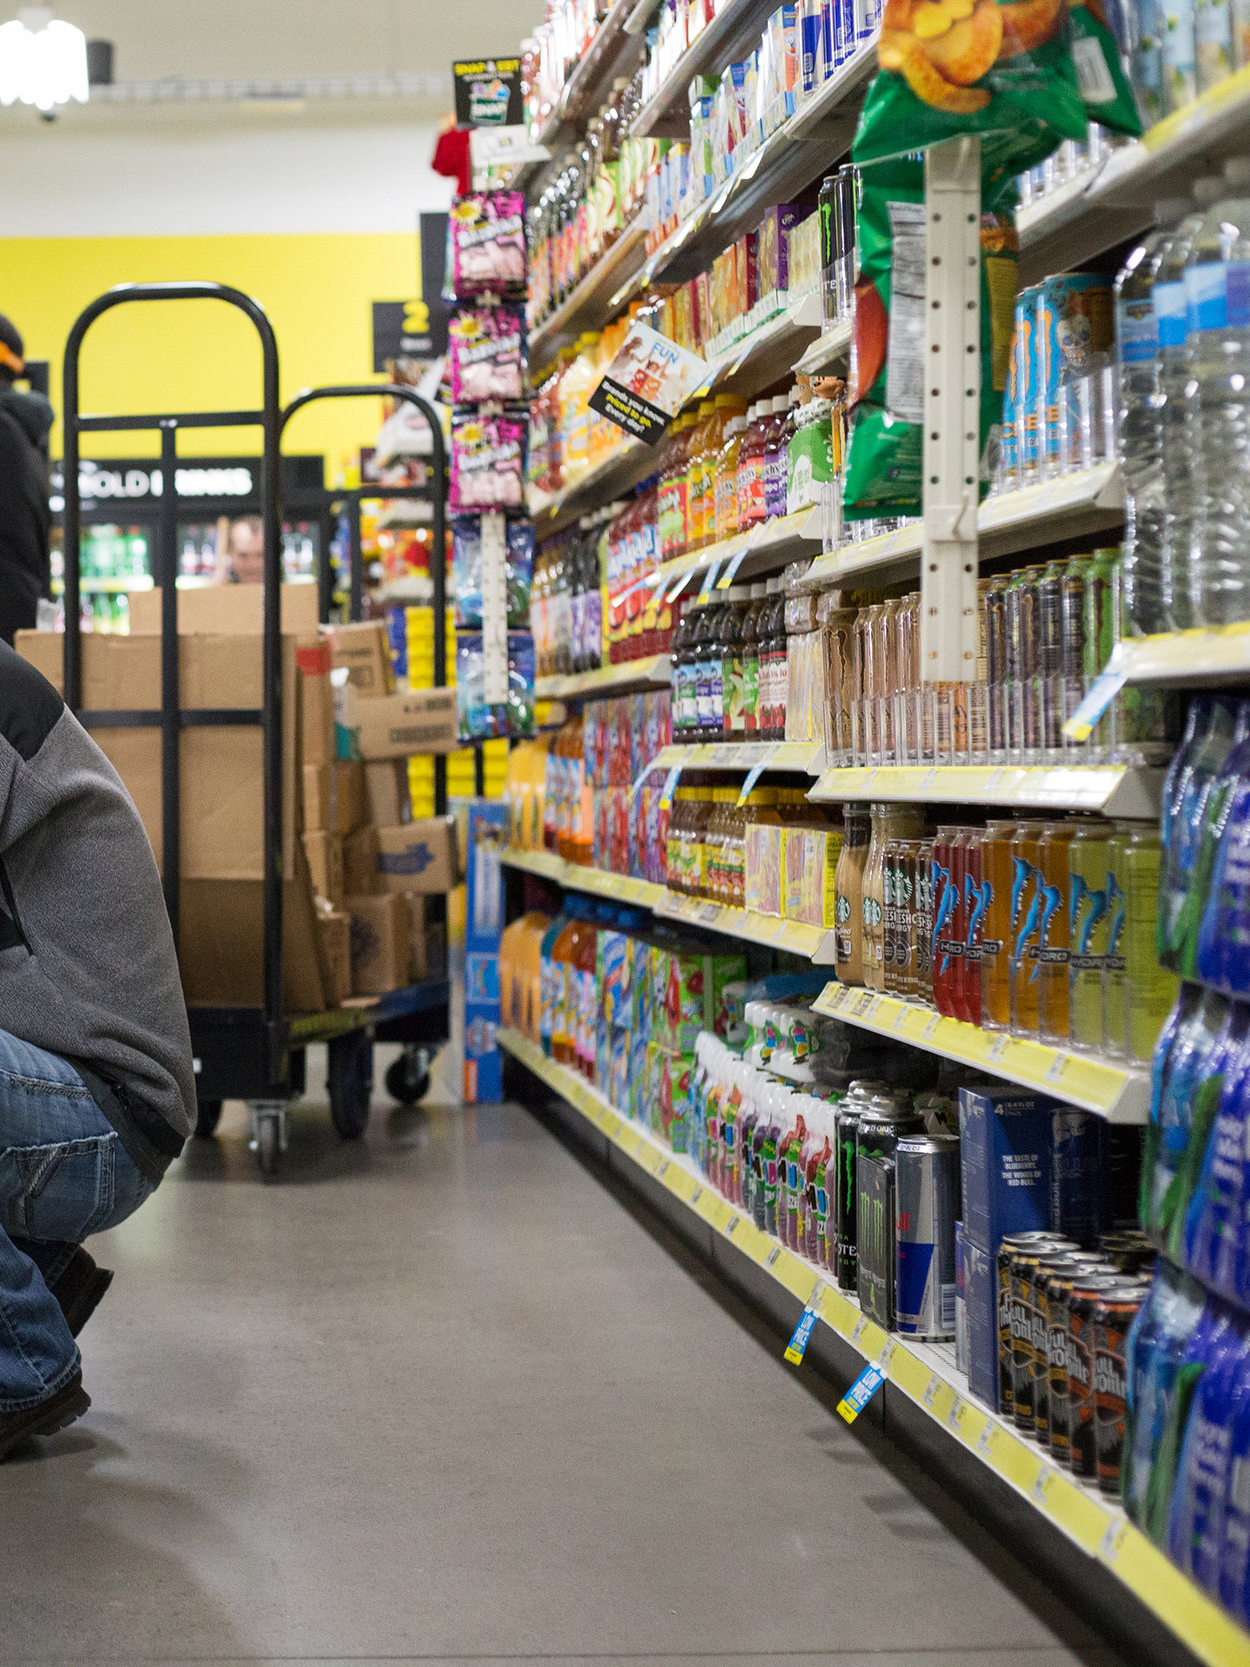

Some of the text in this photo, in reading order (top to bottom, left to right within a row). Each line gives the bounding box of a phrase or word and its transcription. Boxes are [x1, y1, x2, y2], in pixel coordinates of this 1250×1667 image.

[402, 300, 431, 334] 2
[651, 342, 679, 364] FUN
[994, 1103, 1004, 1116] 4
[1001, 1171, 1013, 1179] THE
[861, 1368, 882, 1391] LOW
[850, 1380, 872, 1406] PRICE
